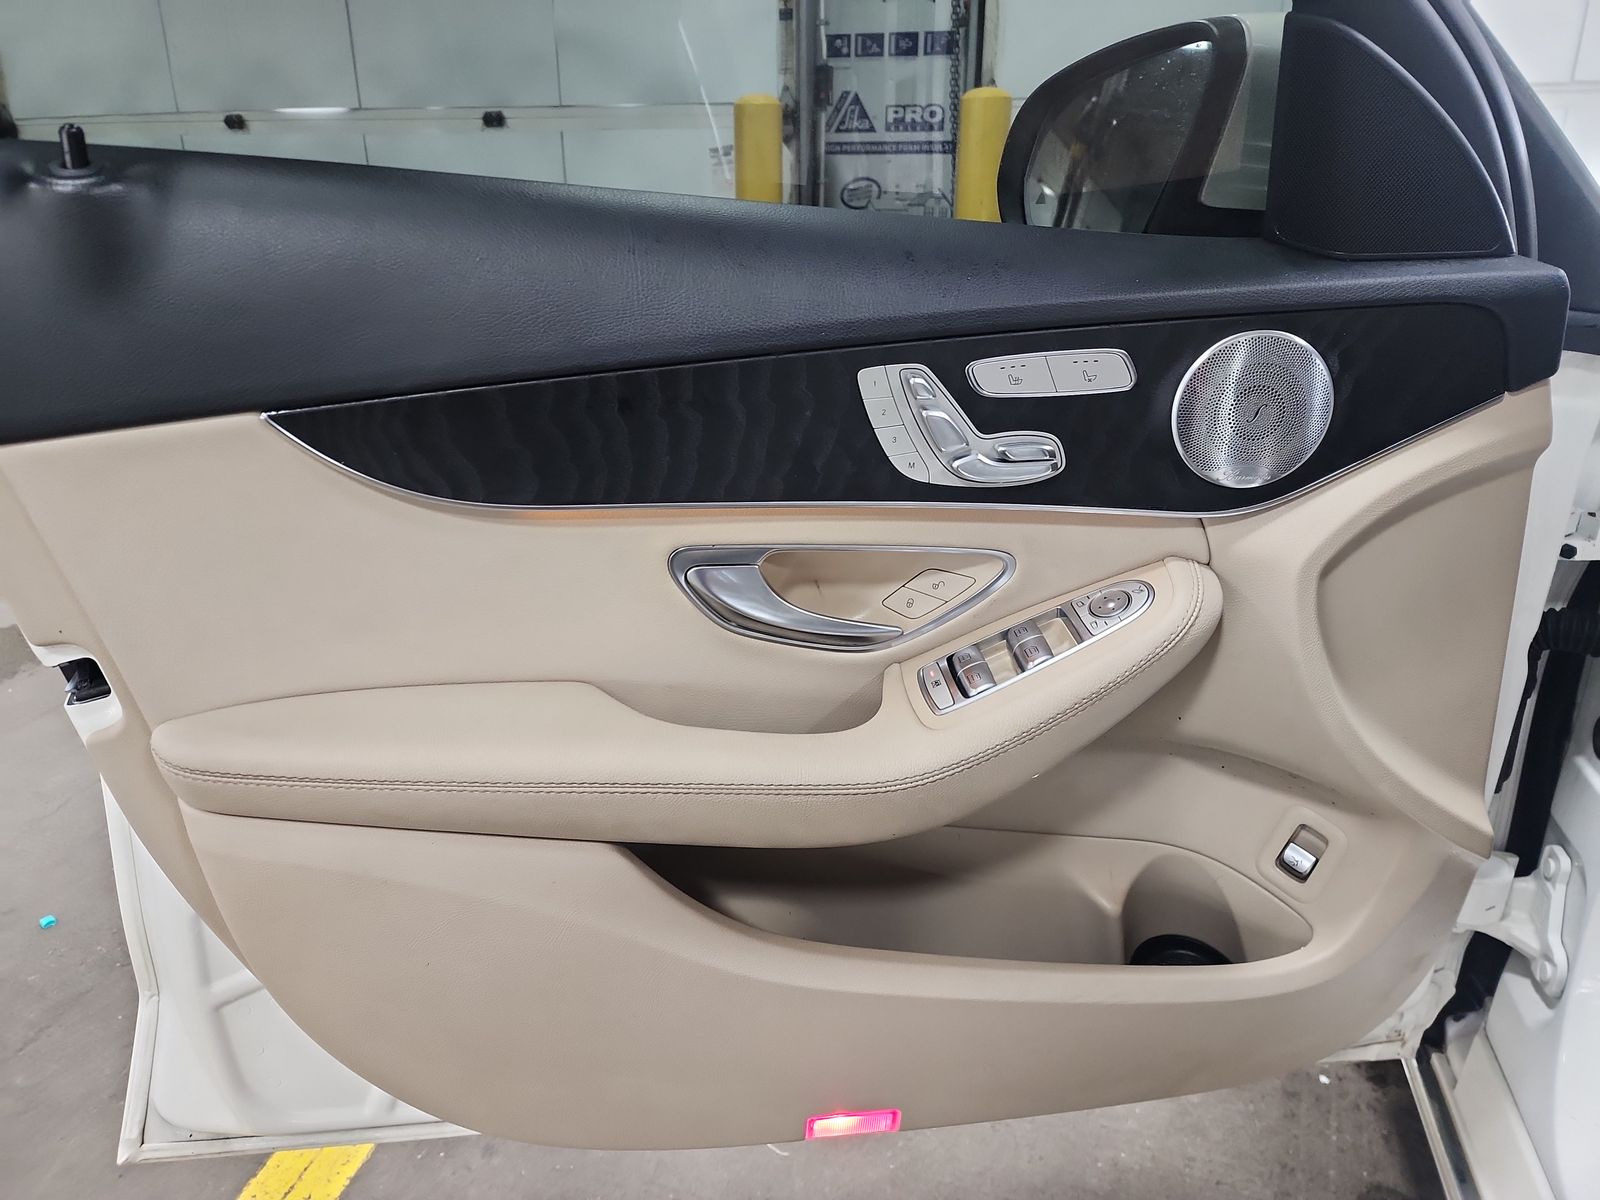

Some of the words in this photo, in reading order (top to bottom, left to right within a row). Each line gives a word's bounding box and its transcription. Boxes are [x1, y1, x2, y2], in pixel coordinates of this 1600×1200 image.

[840, 105, 870, 130] Sika
[886, 105, 943, 122] PRO
[881, 408, 887, 416] 2
[891, 436, 898, 444] 3
